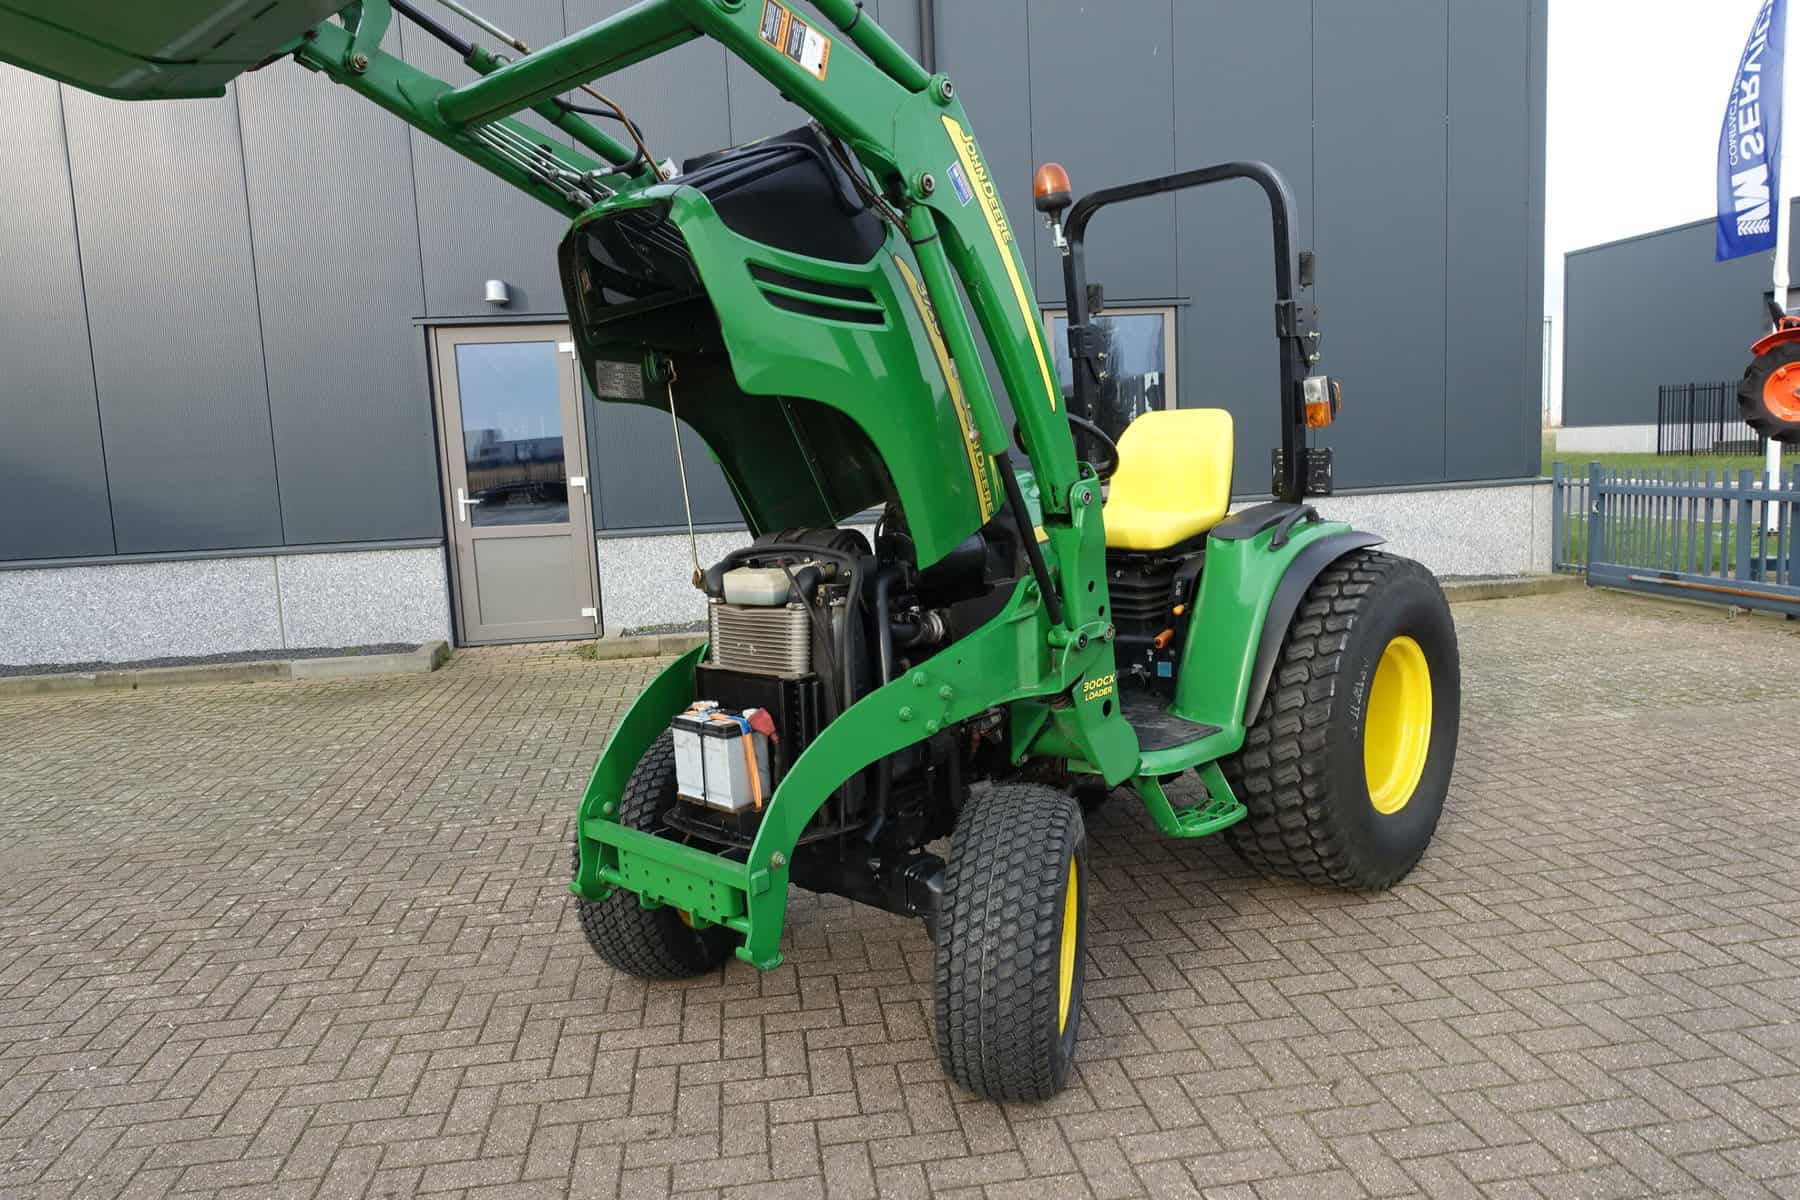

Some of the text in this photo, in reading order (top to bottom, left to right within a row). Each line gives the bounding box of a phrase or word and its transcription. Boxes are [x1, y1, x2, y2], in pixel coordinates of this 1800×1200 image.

[960, 127, 987, 184] JOHN
[982, 181, 1012, 245] DEERE
[975, 450, 994, 514] DEERE
[1083, 673, 1115, 692] 300CX
[1085, 686, 1112, 701] LOADER
